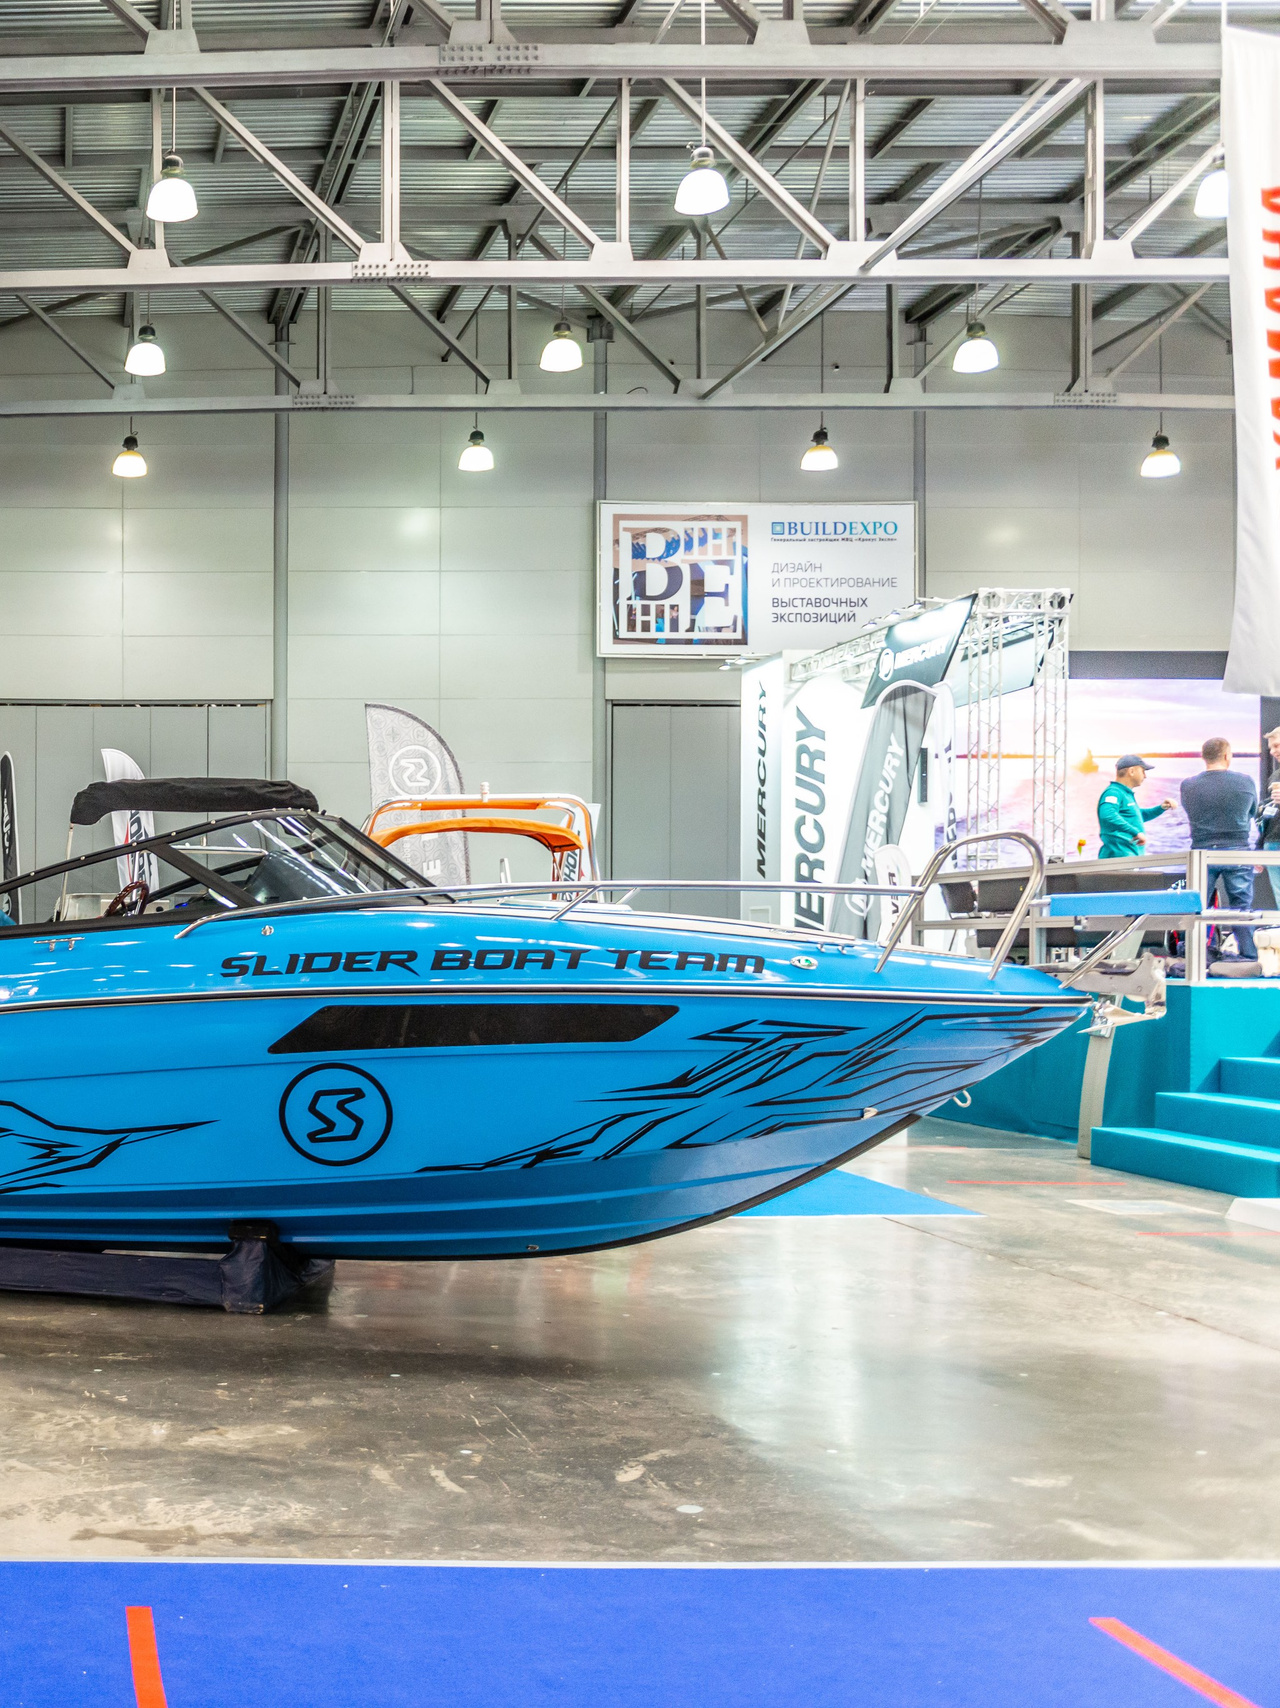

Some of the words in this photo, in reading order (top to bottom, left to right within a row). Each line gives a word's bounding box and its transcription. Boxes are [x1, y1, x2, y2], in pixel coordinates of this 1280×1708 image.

[787, 521, 898, 536] BUILDEXPO
[772, 561, 822, 573] ДИЗАЙН
[772, 577, 780, 588] И
[784, 577, 898, 588] ПРОЕКТИРОВАНИЕ
[772, 597, 868, 608] ВЫСТАВОЧНЫХ
[772, 610, 856, 624] ЭКСПОЗИЦИЙ
[756, 681, 767, 879] MERCURY
[861, 732, 905, 876] MERCURY
[794, 705, 826, 931] ERCURY
[219, 950, 420, 977] SLIDER
[430, 949, 591, 971] BOAT
[608, 950, 765, 974] TEAM
